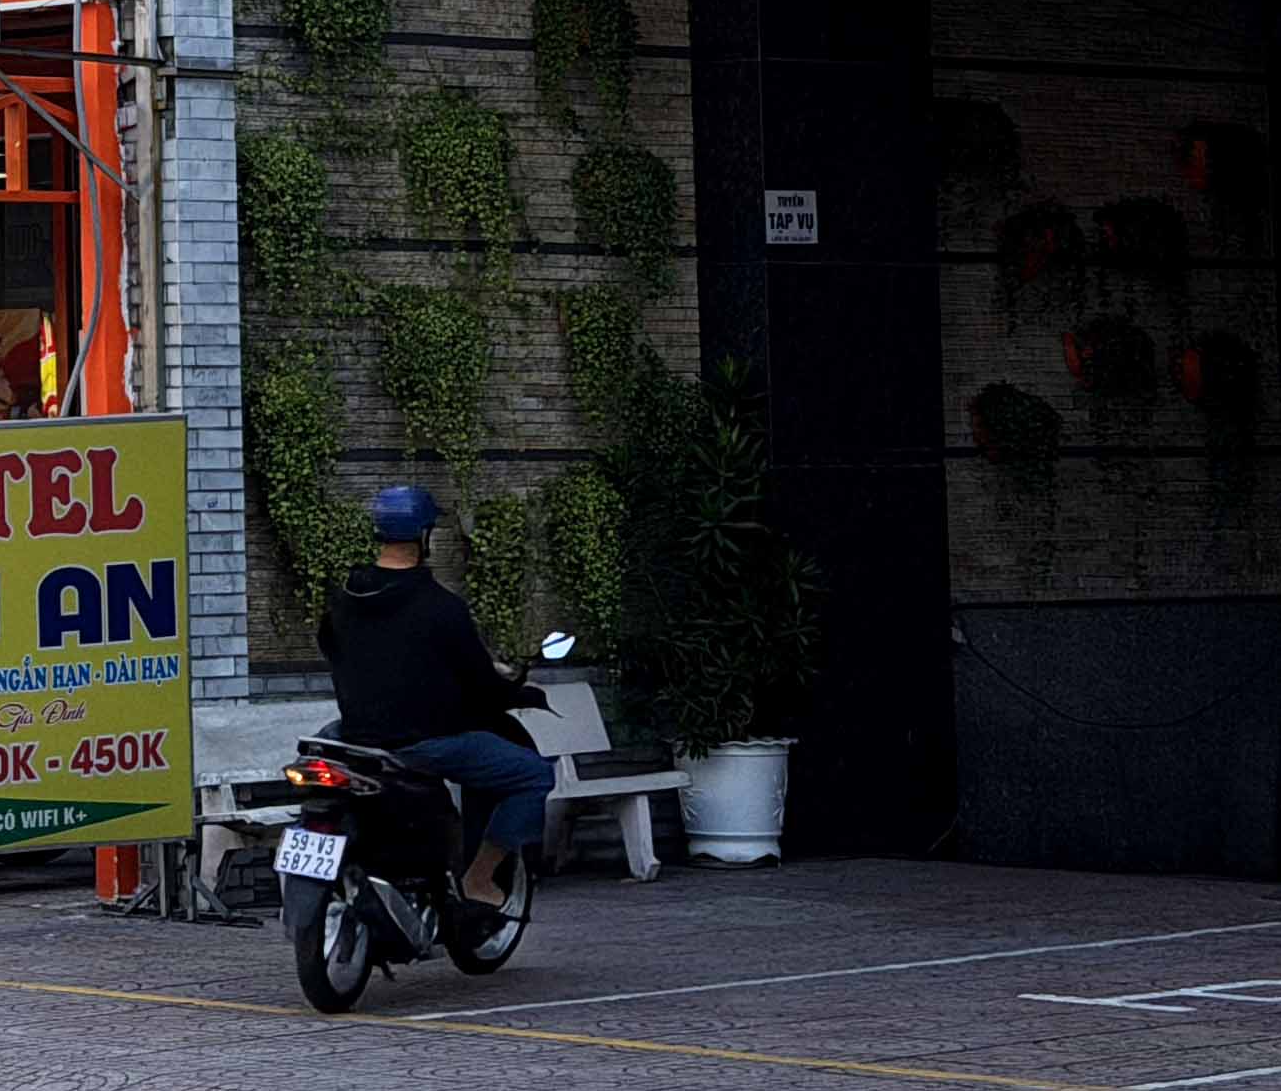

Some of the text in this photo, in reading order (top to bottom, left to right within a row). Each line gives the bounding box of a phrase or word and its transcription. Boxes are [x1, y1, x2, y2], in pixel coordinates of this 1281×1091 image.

[768, 212, 814, 234] TẠP VỤ
[37, 558, 179, 650] AN
[52, 663, 92, 695] HẠN
[105, 653, 138, 686] DÀI
[141, 653, 180, 687] HẠN
[69, 728, 170, 780] 450K
[20, 808, 59, 830] WIFI
[59, 807, 88, 826] K+
[290, 832, 336, 856] 59-V3
[280, 851, 335, 877] 587.22
